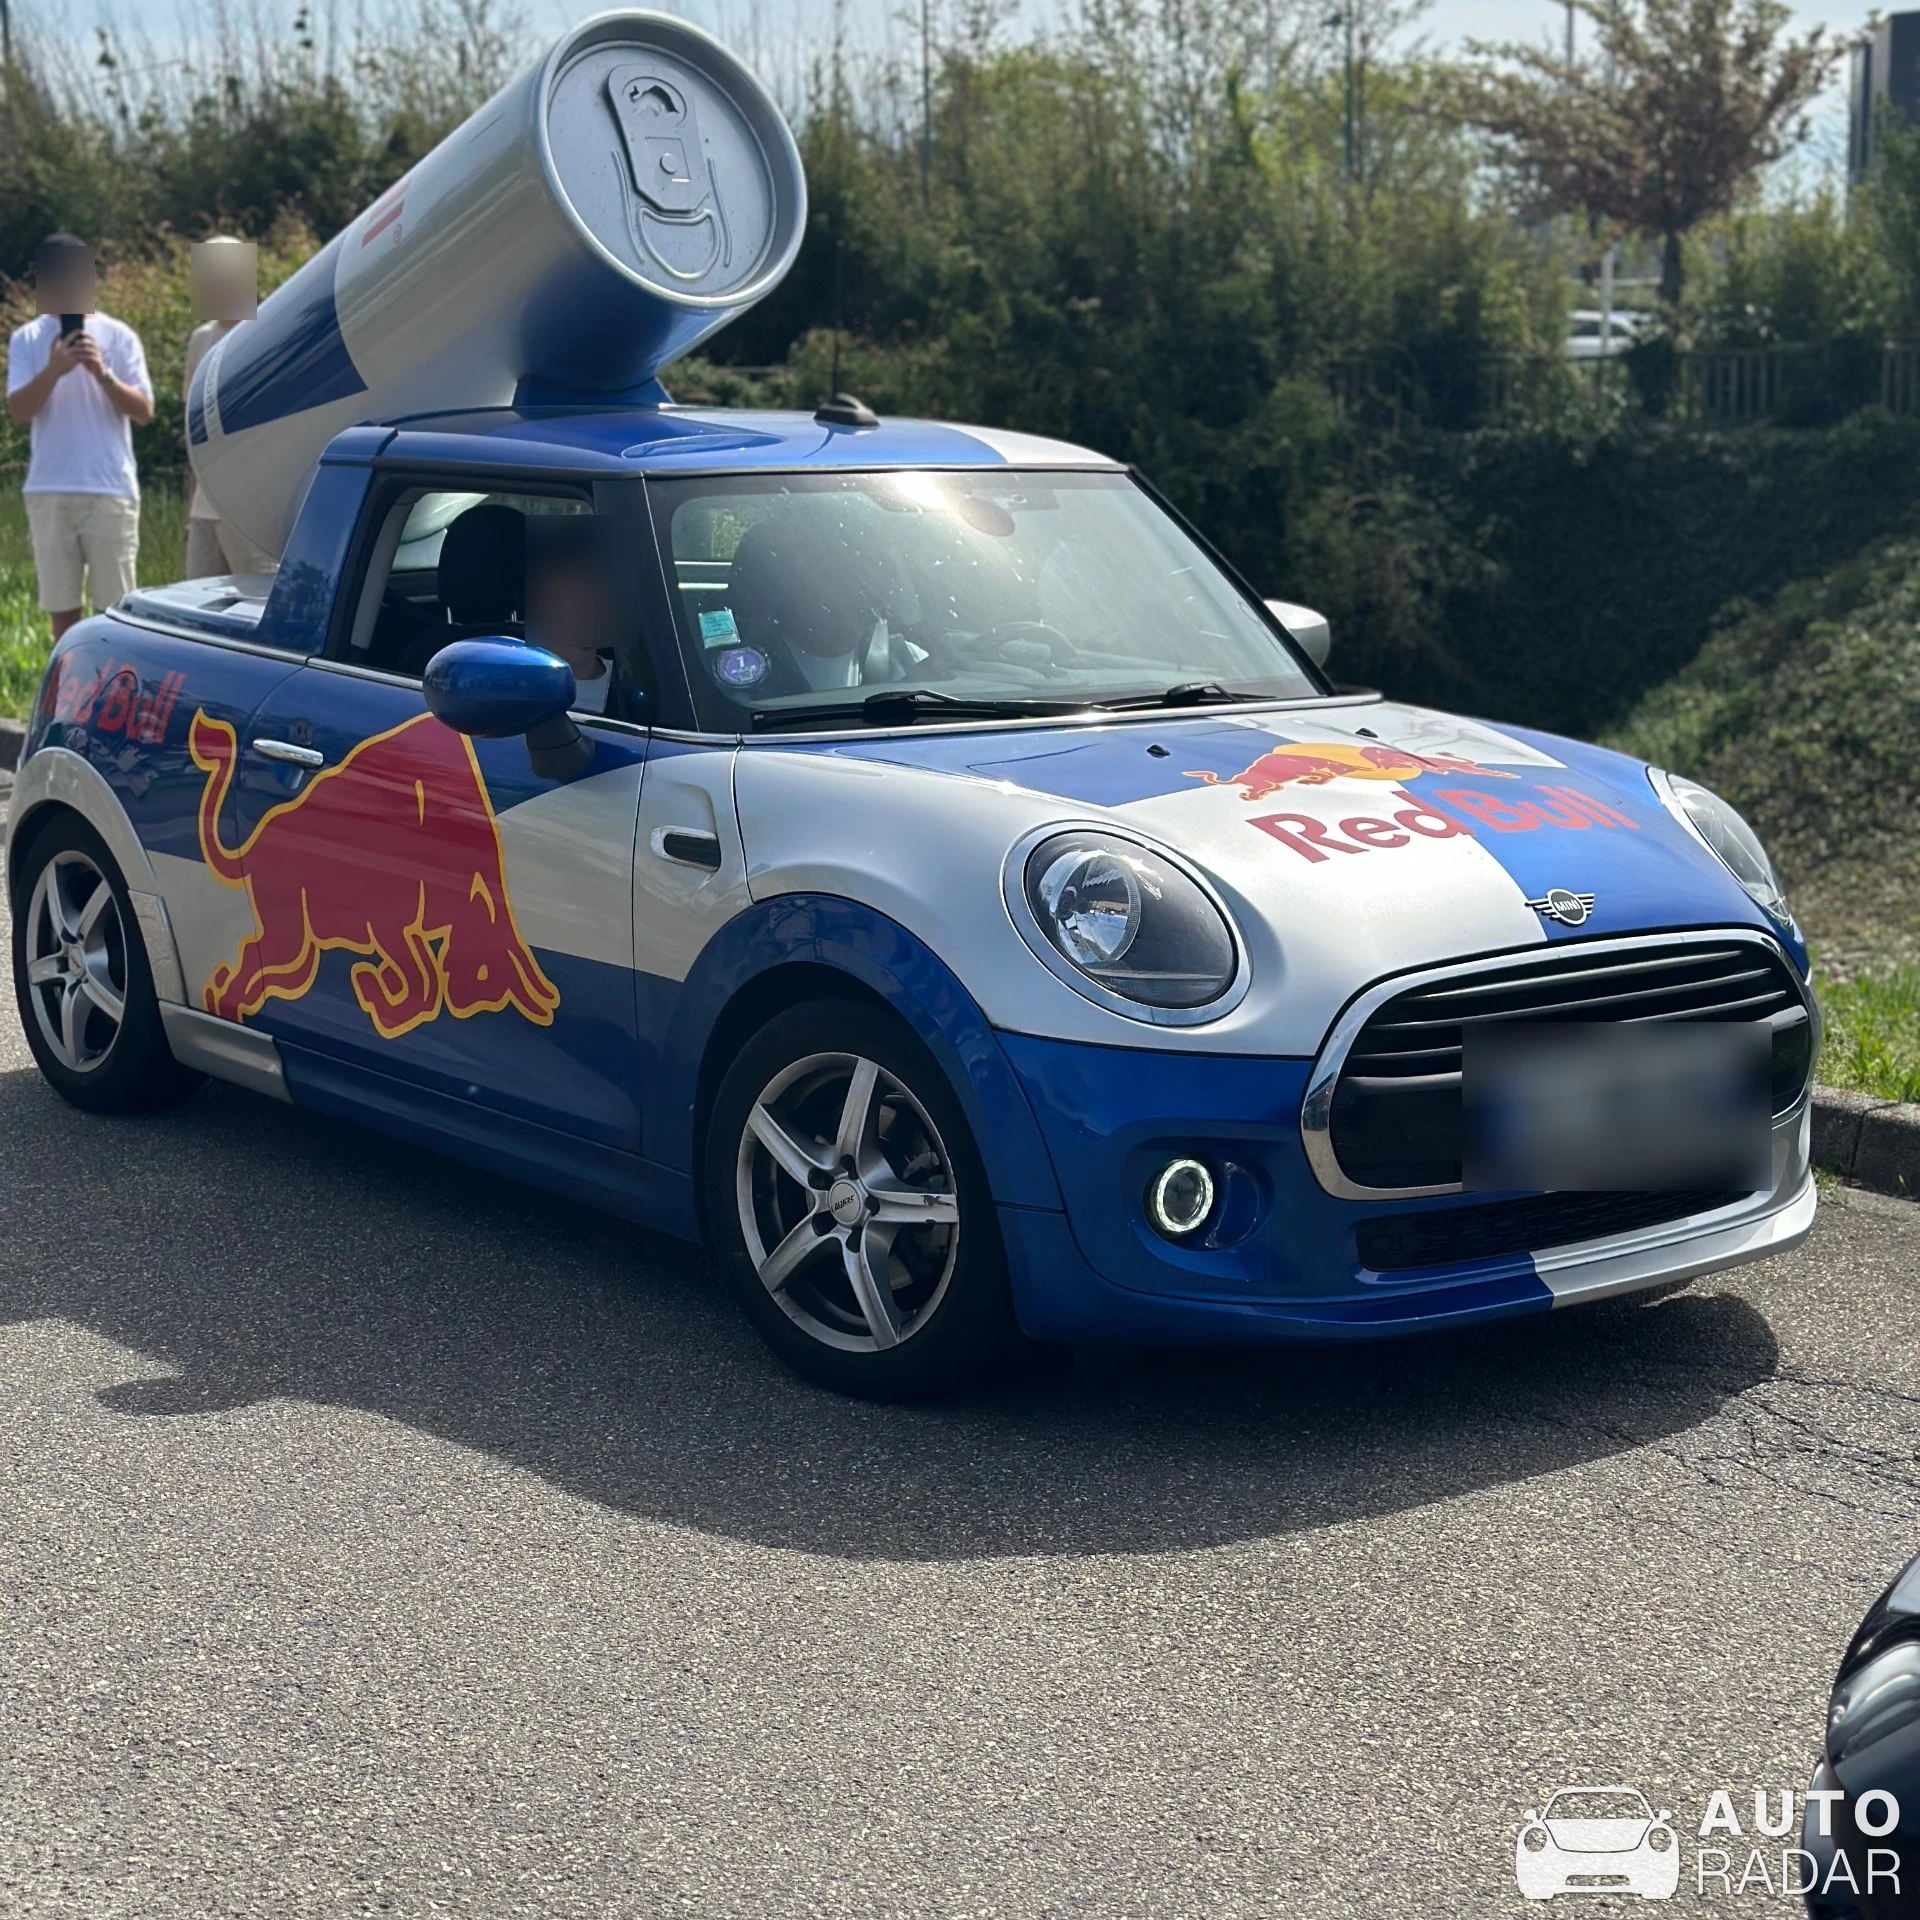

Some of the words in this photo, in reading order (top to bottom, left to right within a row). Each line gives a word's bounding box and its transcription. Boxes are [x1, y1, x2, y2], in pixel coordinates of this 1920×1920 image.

[736, 655, 745, 668] 1
[97, 663, 187, 744] Bull
[1245, 791, 1476, 863] Red
[1433, 784, 1641, 832] Bull
[1553, 899, 1582, 912] MINI
